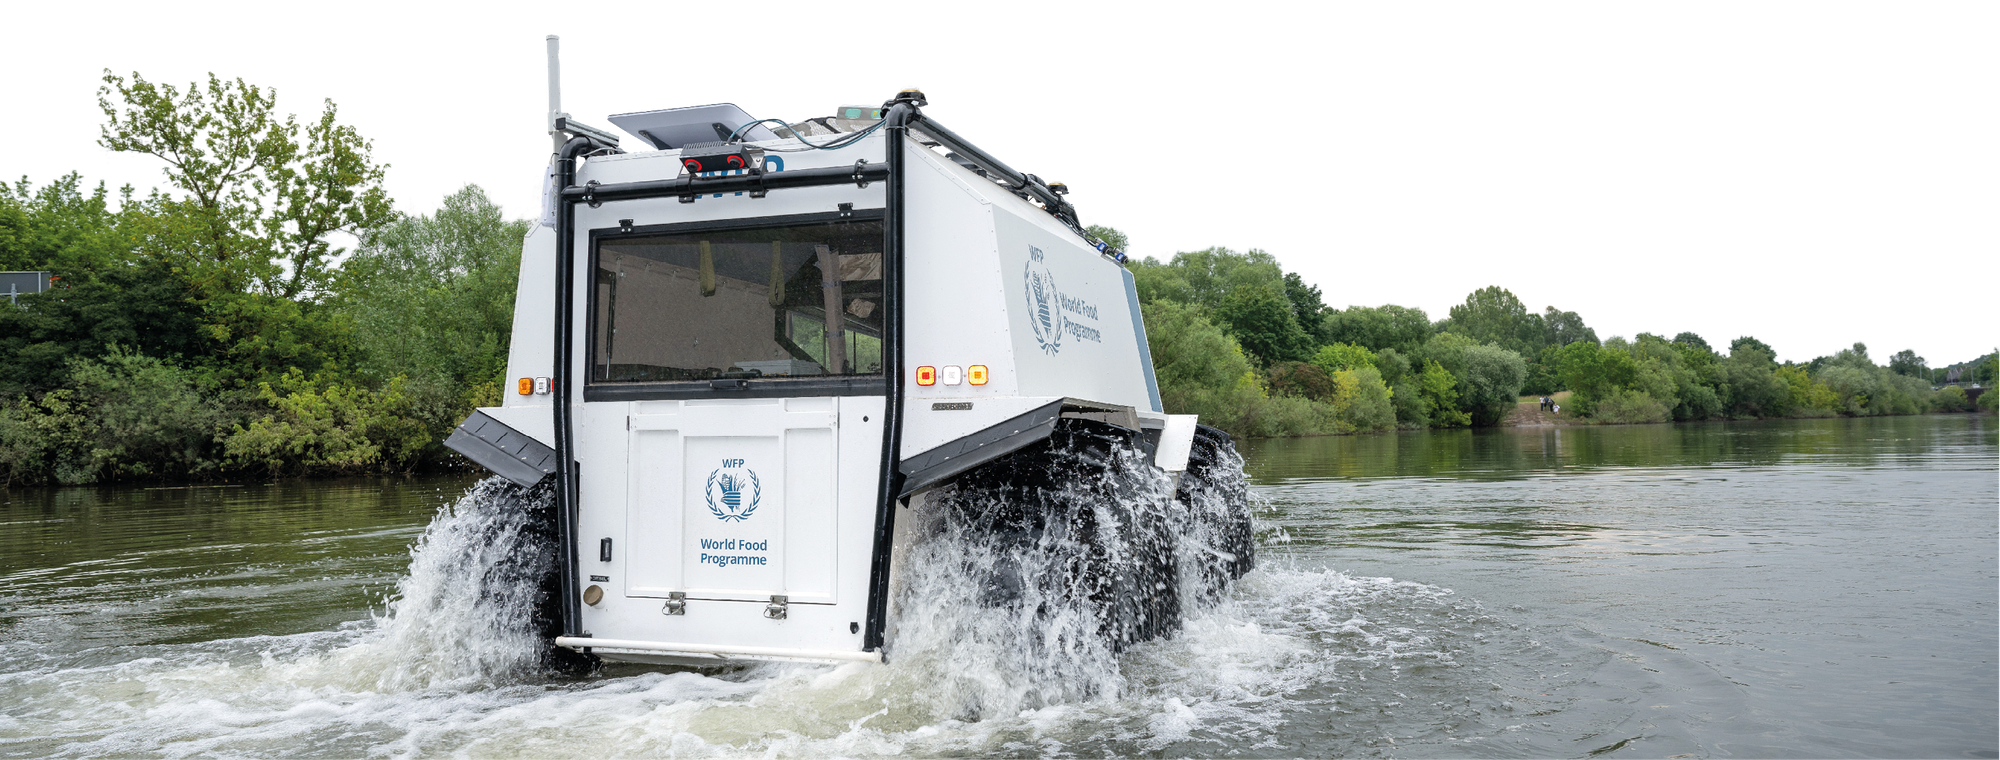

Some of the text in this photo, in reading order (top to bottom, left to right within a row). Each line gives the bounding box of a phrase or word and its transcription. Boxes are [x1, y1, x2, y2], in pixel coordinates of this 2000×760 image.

[1028, 243, 1044, 264] WFP
[1059, 291, 1099, 321] World Food
[1063, 315, 1101, 343] Programme
[722, 458, 745, 469] WFP
[700, 538, 767, 552] World Food
[700, 553, 767, 567] Programme
